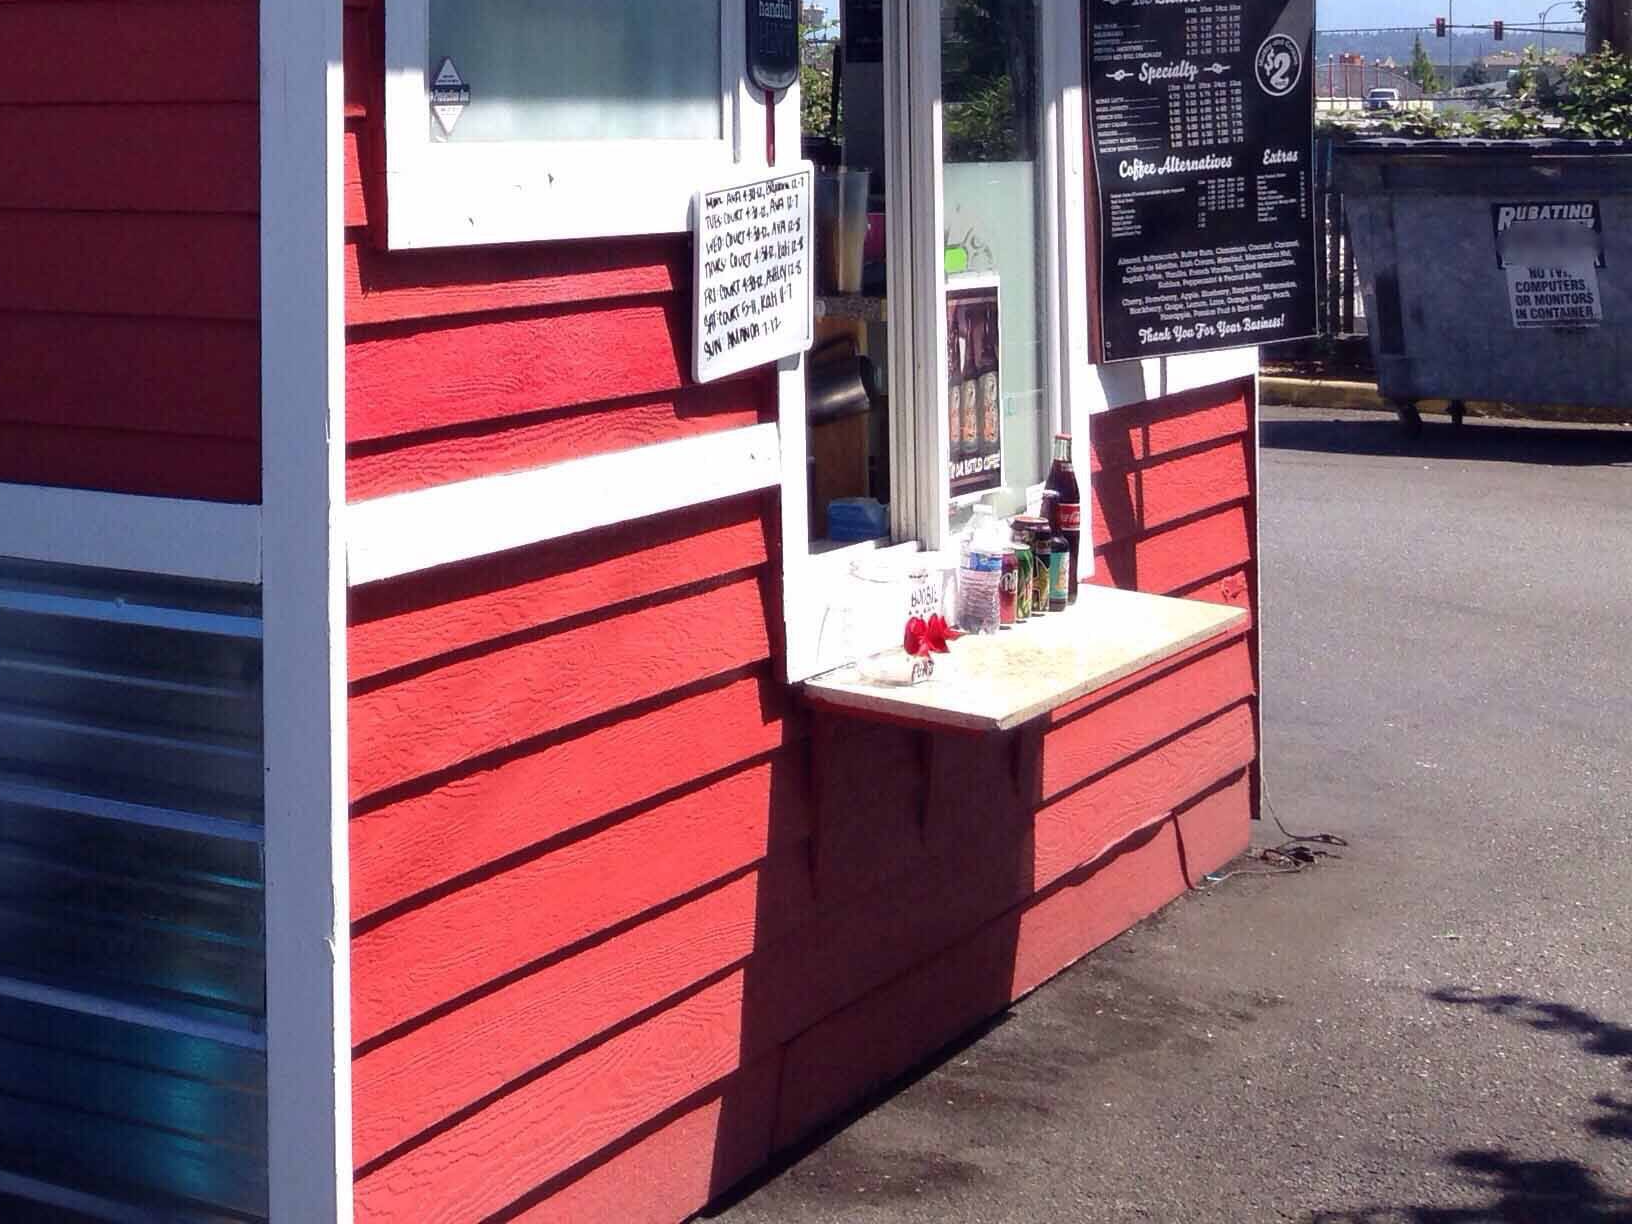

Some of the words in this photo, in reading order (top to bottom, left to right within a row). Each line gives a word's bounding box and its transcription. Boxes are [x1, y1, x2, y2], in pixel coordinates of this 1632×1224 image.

[1139, 60, 1199, 85] Specialty
[1119, 158, 1156, 181] Coffee
[1158, 153, 1232, 175] Alternatives
[1262, 149, 1299, 166] Extras
[1497, 204, 1594, 232] RUBATINO
[1515, 294, 1532, 307] OR
[1534, 293, 1595, 307] MONITORS
[1515, 308, 1528, 320] IN
[1530, 306, 1594, 320] CONTAINER
[1138, 327, 1172, 344] Thank
[1172, 325, 1195, 343] You
[1195, 322, 1216, 340] For
[1216, 320, 1242, 338] Your
